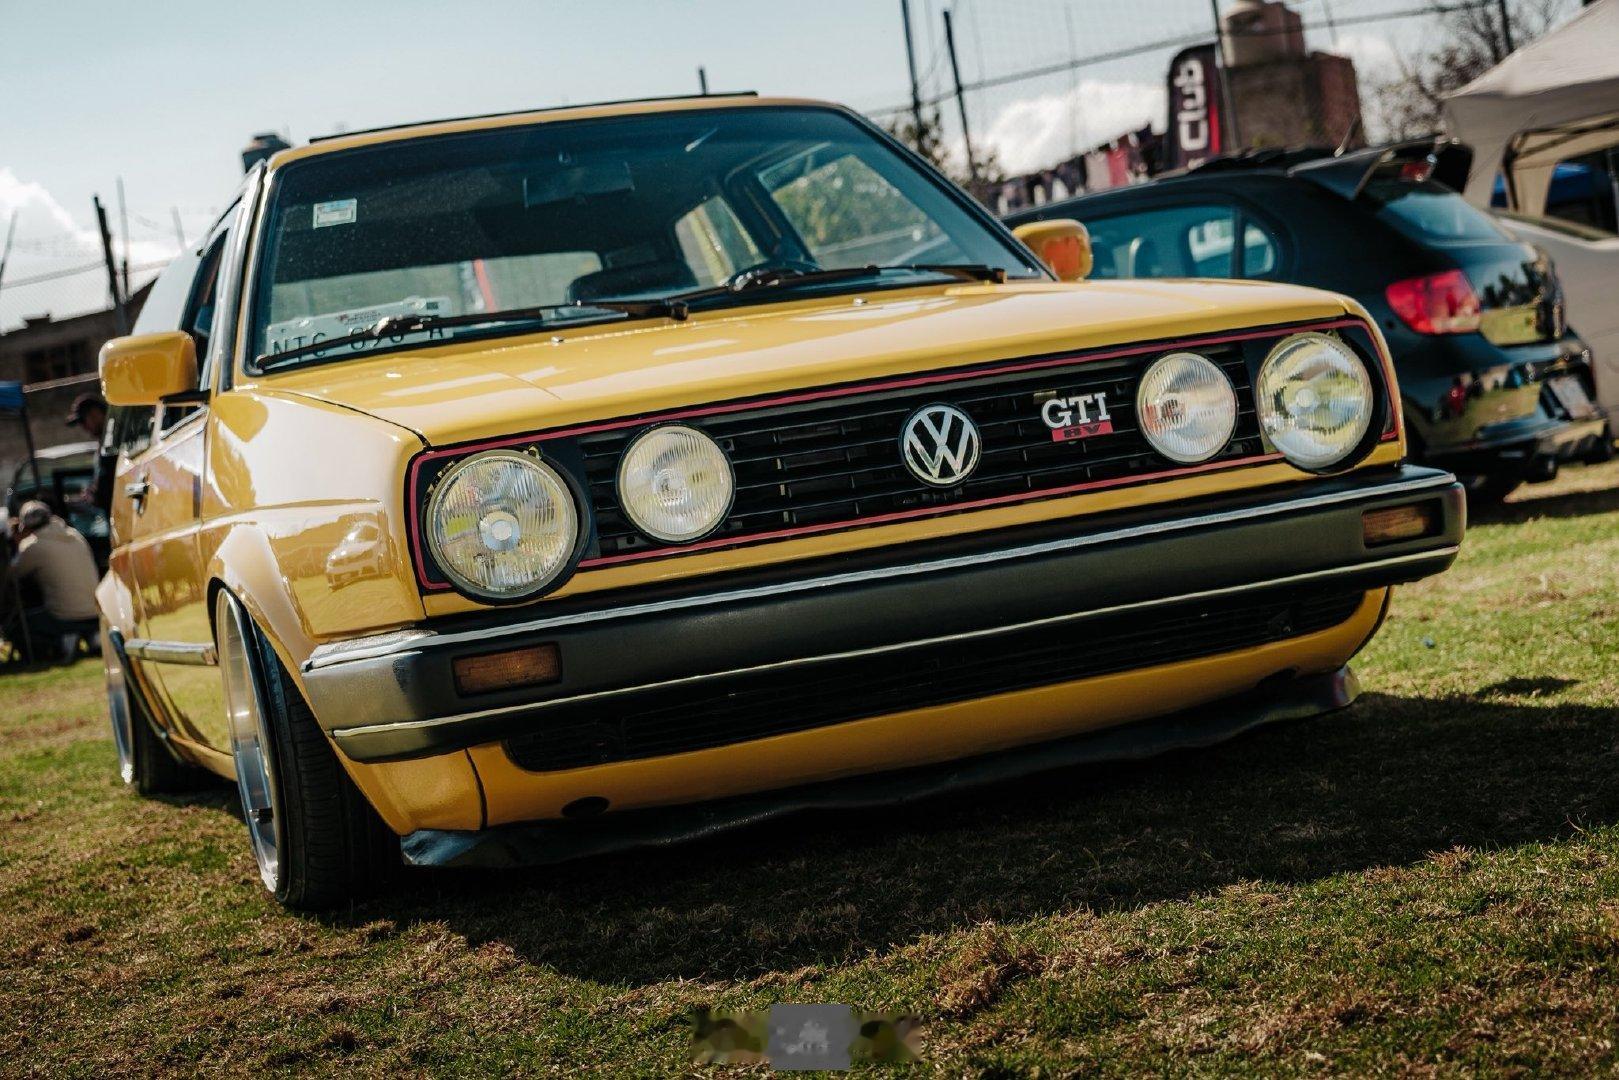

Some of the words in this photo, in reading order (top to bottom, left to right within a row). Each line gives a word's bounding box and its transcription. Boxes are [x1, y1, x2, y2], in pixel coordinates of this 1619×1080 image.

[1174, 59, 1208, 151] Club
[903, 404, 978, 484] VW
[1042, 392, 1111, 429] GTI
